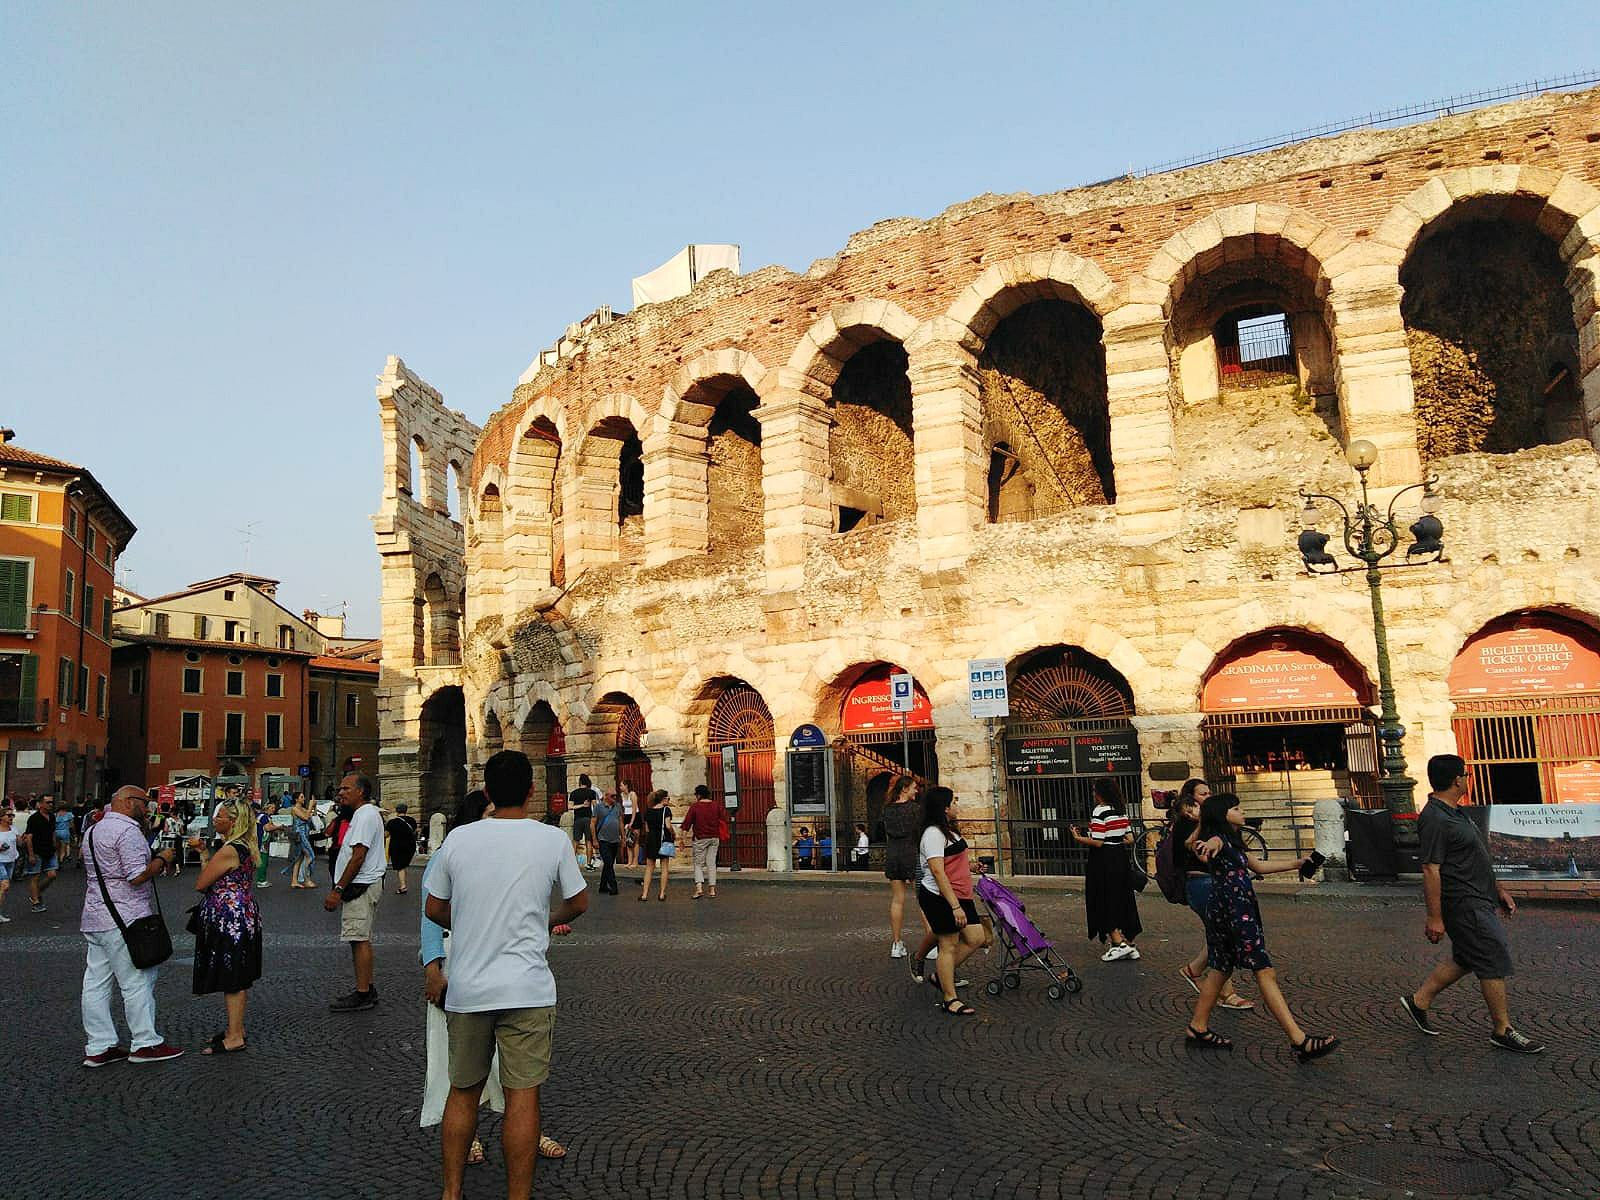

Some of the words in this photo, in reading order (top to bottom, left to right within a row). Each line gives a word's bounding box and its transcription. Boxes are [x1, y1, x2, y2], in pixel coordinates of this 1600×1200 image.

[1482, 643, 1568, 656] BIGLIETTERIA
[1480, 654, 1526, 665] TICKET
[1527, 651, 1574, 663] OFFICE
[1220, 663, 1289, 676] GRADINATA
[1485, 664, 1527, 674] Cancello
[1538, 664, 1561, 672] Gate
[1562, 662, 1569, 671] 7
[1249, 676, 1280, 685] Entrata
[1289, 674, 1310, 683] Gate
[1023, 739, 1069, 747] ANFITEATRO
[1508, 808, 1536, 816] Arena
[1538, 807, 1547, 816] di
[1550, 807, 1584, 816] Verona
[1513, 817, 1542, 827] Opera
[1545, 816, 1579, 826] Festival
